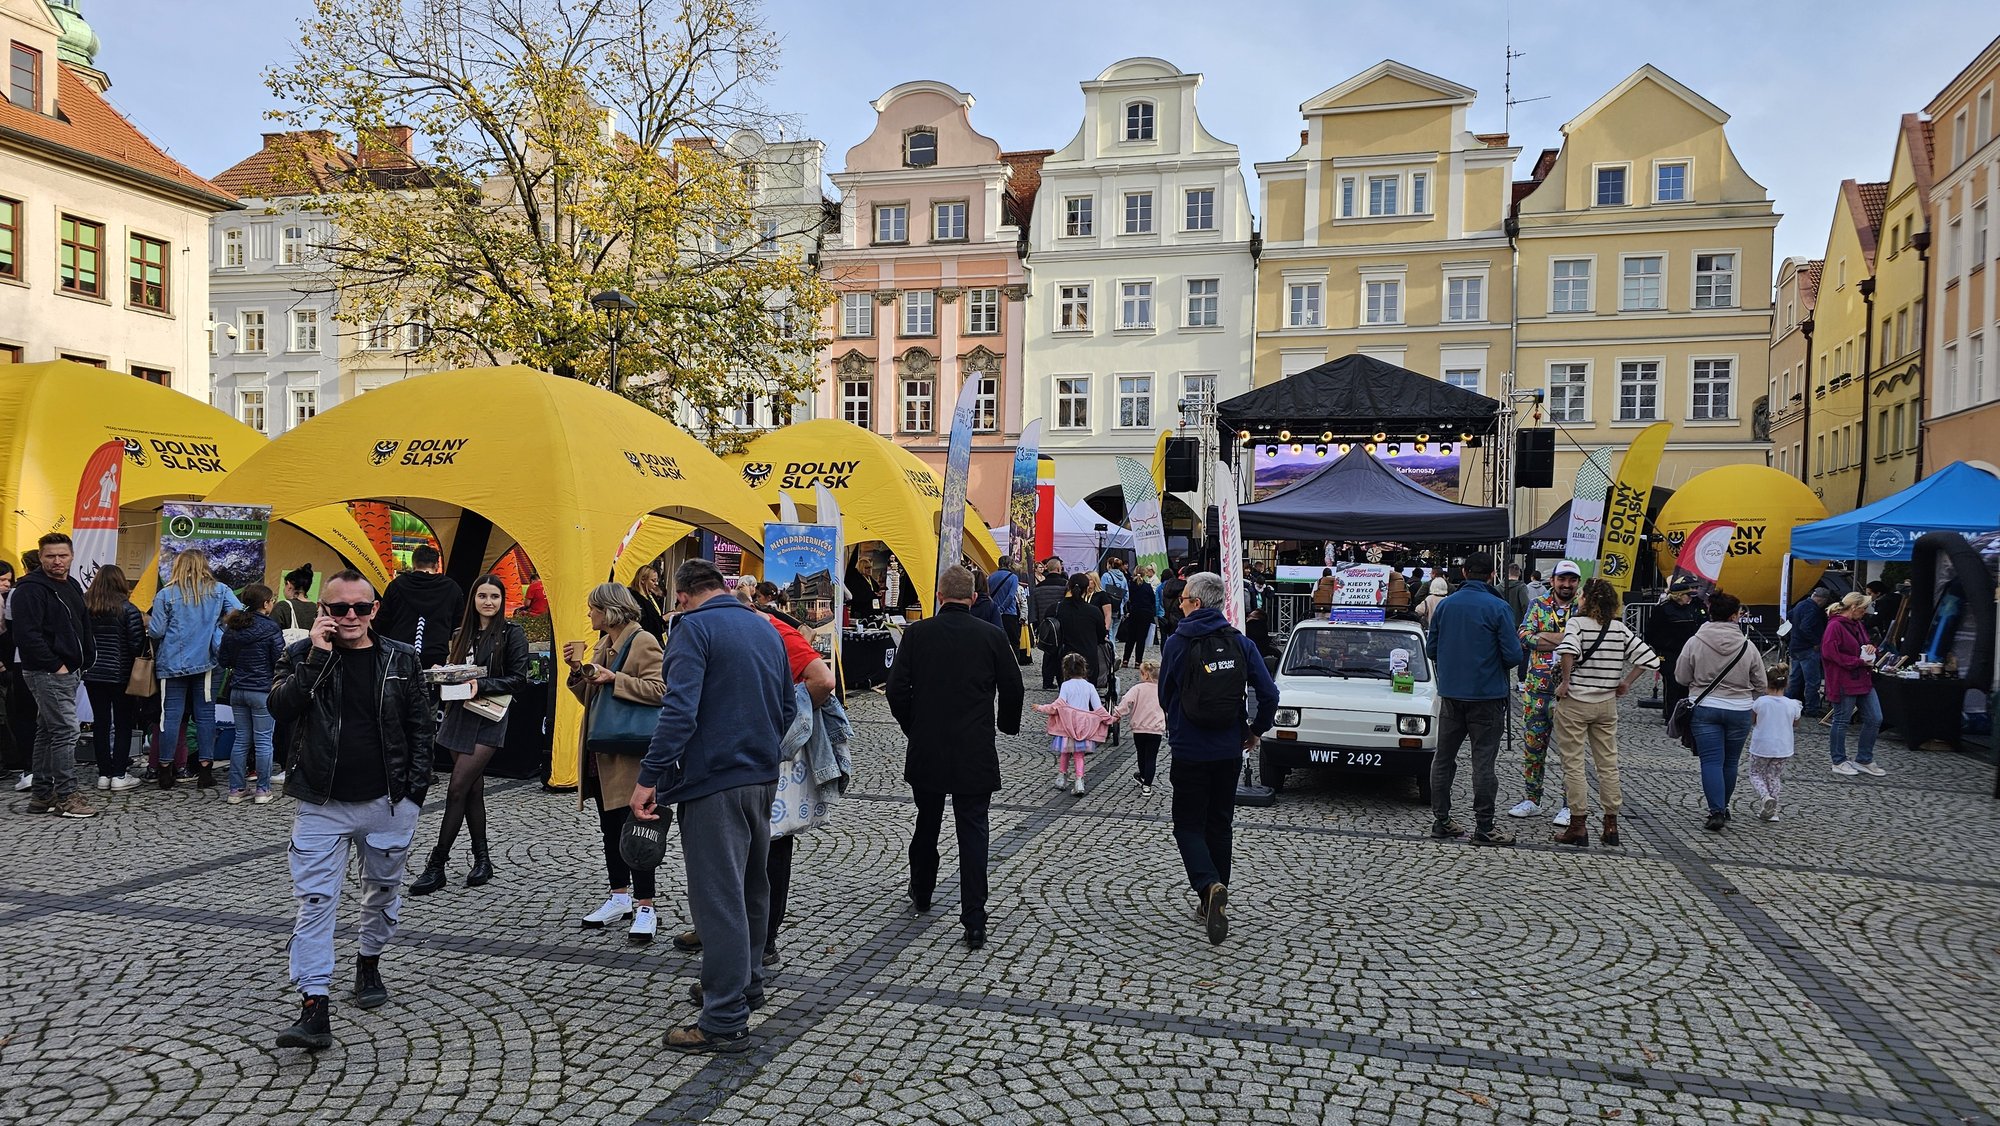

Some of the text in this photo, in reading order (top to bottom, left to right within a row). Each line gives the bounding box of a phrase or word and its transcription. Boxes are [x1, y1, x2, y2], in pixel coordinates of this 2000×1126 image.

[150, 439, 219, 457] DOLNY
[407, 438, 469, 451] DOLNY
[160, 452, 228, 474] ŚLĄSK
[400, 449, 458, 467] ŚLĄSK
[640, 453, 677, 468] DOLNY
[784, 460, 861, 474] DOLNY
[1396, 466, 1436, 475] Karkonoszy
[1607, 480, 1631, 543] DOLNY
[1620, 488, 1646, 546] ŚLĄSK
[199, 521, 224, 529] KOPALNIA
[770, 535, 833, 552] MŁYN PAPIERNICZY
[331, 527, 388, 584] www.dolnyslask.travel
[1309, 749, 1382, 766] WWF 2492
[632, 825, 660, 843] NIRVANA
